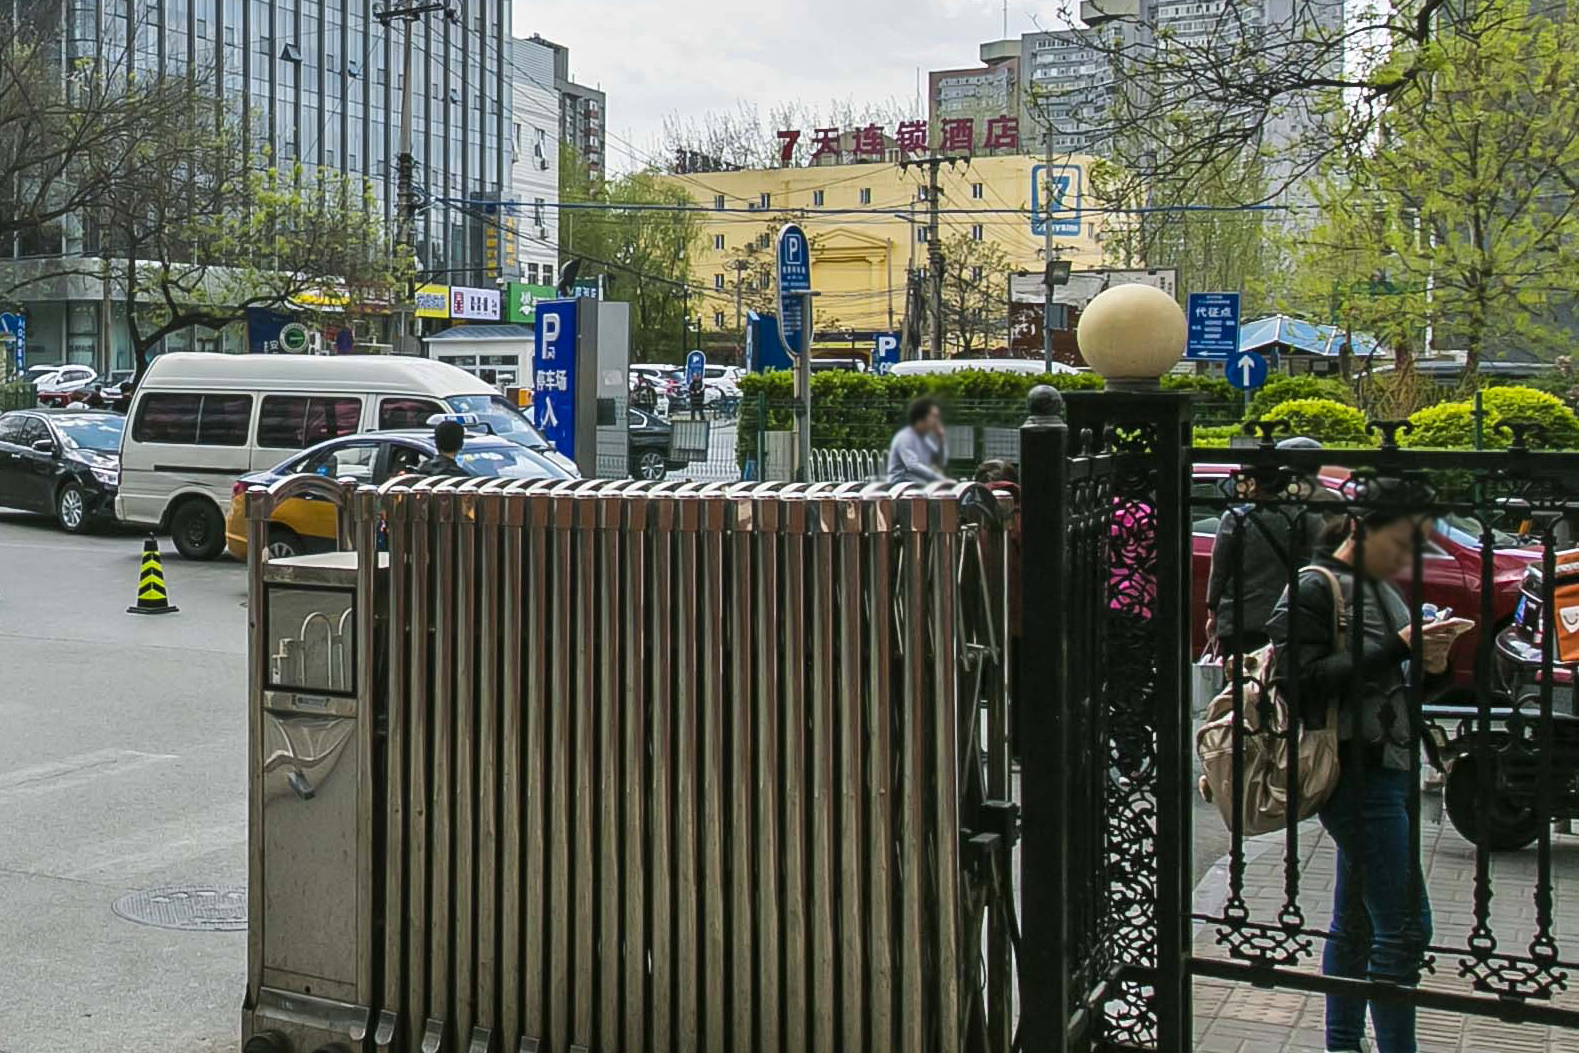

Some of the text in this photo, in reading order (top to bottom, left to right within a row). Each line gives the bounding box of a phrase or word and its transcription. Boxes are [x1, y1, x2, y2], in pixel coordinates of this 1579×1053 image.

[789, 237, 798, 261] P
[542, 312, 561, 360] P
[878, 336, 897, 357] P
[537, 369, 568, 391] 停车场
